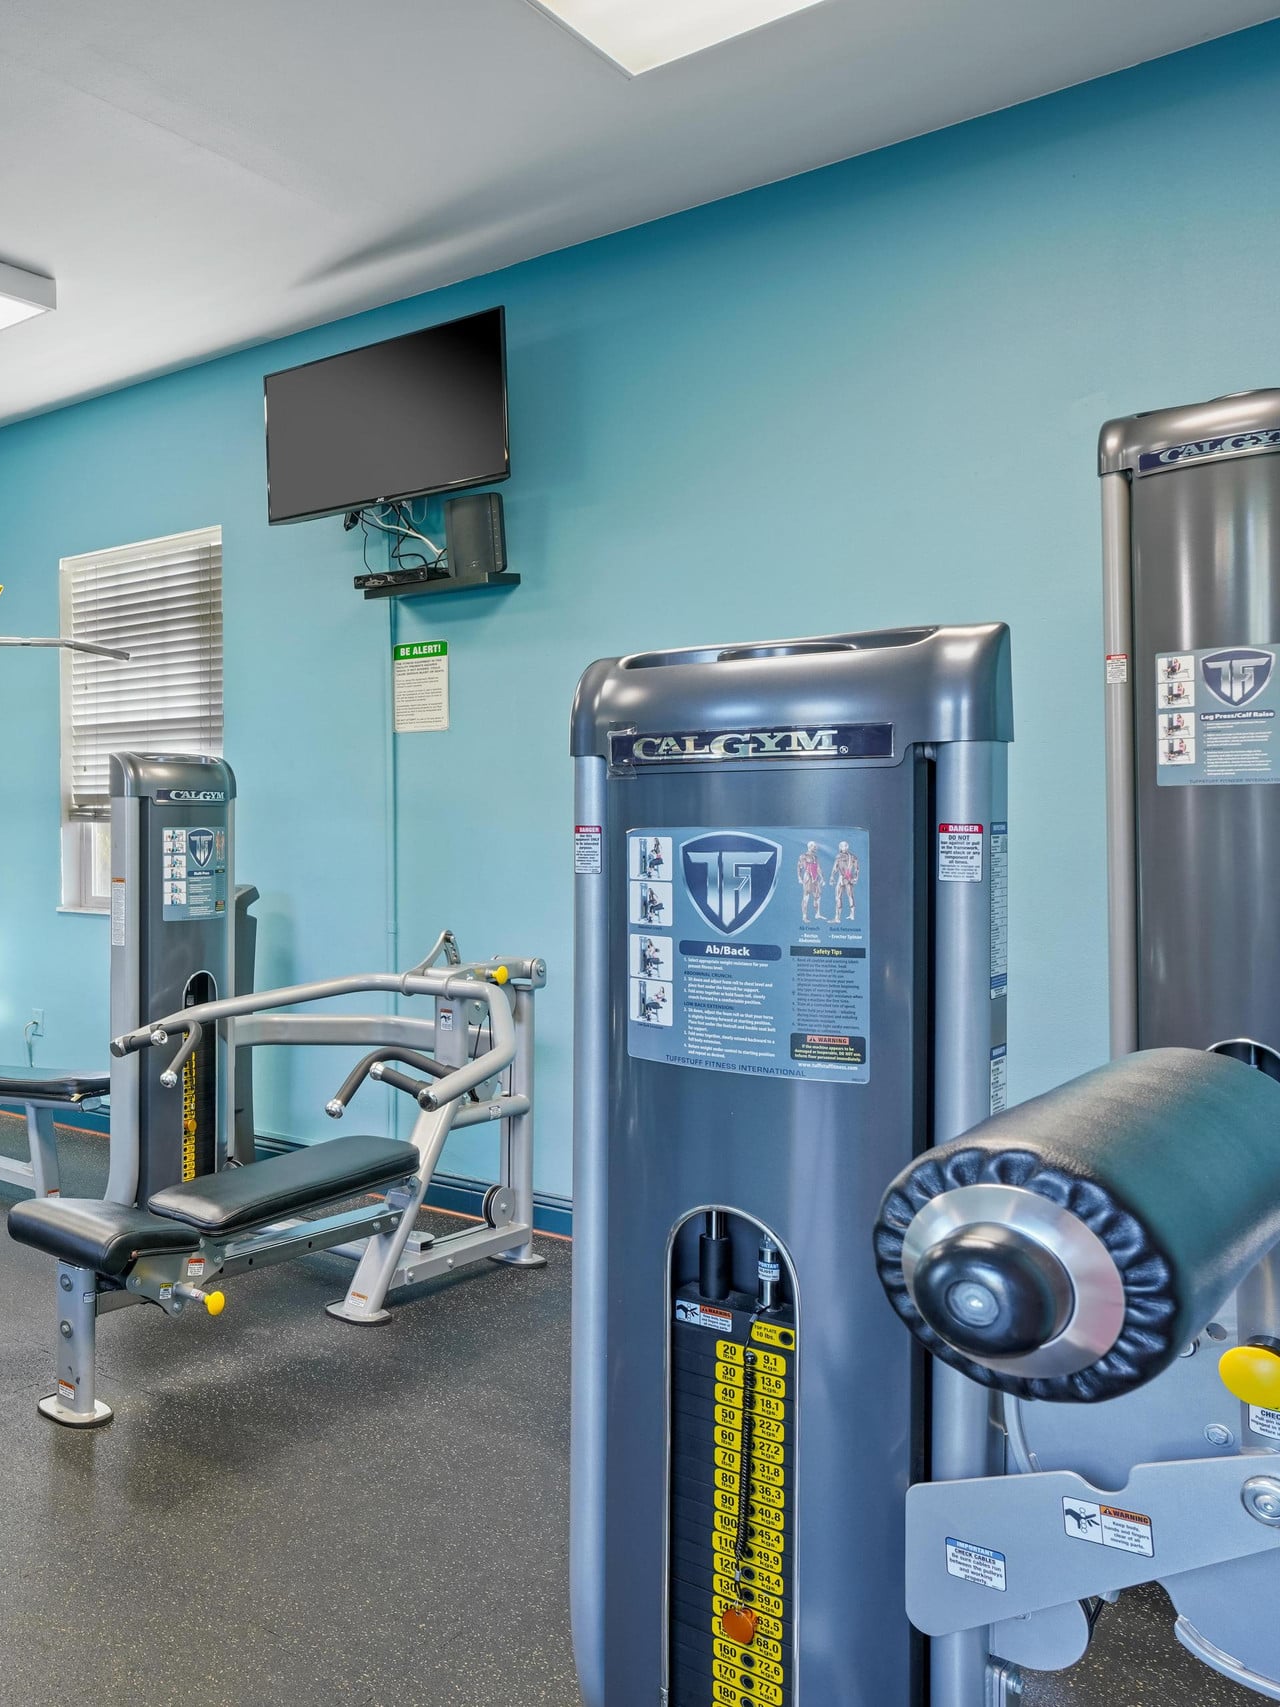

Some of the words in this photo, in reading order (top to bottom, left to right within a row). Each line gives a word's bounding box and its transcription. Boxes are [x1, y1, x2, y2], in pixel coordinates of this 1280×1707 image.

[400, 647, 410, 656] BE
[412, 644, 441, 655] ALERT!
[633, 730, 838, 760] CALGYM
[170, 790, 224, 800] CALGYM
[705, 945, 750, 956] Ab/Back
[666, 1055, 704, 1066] TUFFSTUFF
[705, 1060, 737, 1070] FITNESS
[738, 1065, 806, 1077] INTERNATIONAL
[708, 1308, 731, 1317] WARNING
[723, 1344, 736, 1356] 20
[763, 1355, 777, 1366] 9.1
[722, 1366, 735, 1377] 30
[760, 1376, 781, 1389] 13.6
[721, 1388, 735, 1399] 40
[760, 1399, 779, 1411] 18.1
[721, 1409, 735, 1420] 50
[1261, 1410, 1280, 1420] CHEC
[759, 1419, 780, 1432] 22.7
[721, 1430, 734, 1442] 60
[759, 1442, 780, 1455] 27.2
[721, 1451, 735, 1463] 70
[760, 1464, 780, 1477] 31.8
[721, 1473, 735, 1485] 80
[759, 1485, 781, 1499] 36.3
[721, 1494, 734, 1506] 90
[759, 1508, 780, 1521] 40.8
[1112, 1510, 1148, 1524] WARNING
[719, 1515, 737, 1529] 100
[759, 1530, 780, 1544] 45.4
[1104, 1525, 1119, 1533] hands
[1131, 1532, 1149, 1540] fingers
[718, 1536, 735, 1550] 110
[957, 1541, 993, 1556] IMPORTANT
[1110, 1538, 1129, 1546] moving
[757, 1551, 779, 1565] 49.9
[955, 1548, 972, 1558] CHECK
[974, 1554, 996, 1565] CABLES
[719, 1557, 737, 1571] 120
[949, 1558, 972, 1568] between
[983, 1568, 1003, 1578] pulleys
[973, 1559, 991, 1569] cables
[758, 1572, 780, 1587] 54.4
[971, 1570, 993, 1581] working
[719, 1579, 737, 1593] 130
[758, 1594, 780, 1609] 59.0
[757, 1616, 779, 1632] 63.5
[718, 1643, 736, 1658] 160
[757, 1638, 778, 1653] 68.0
[718, 1664, 735, 1679] 170
[758, 1660, 780, 1676] 72.6
[718, 1686, 736, 1700] 180
[758, 1681, 776, 1697] 77.1
